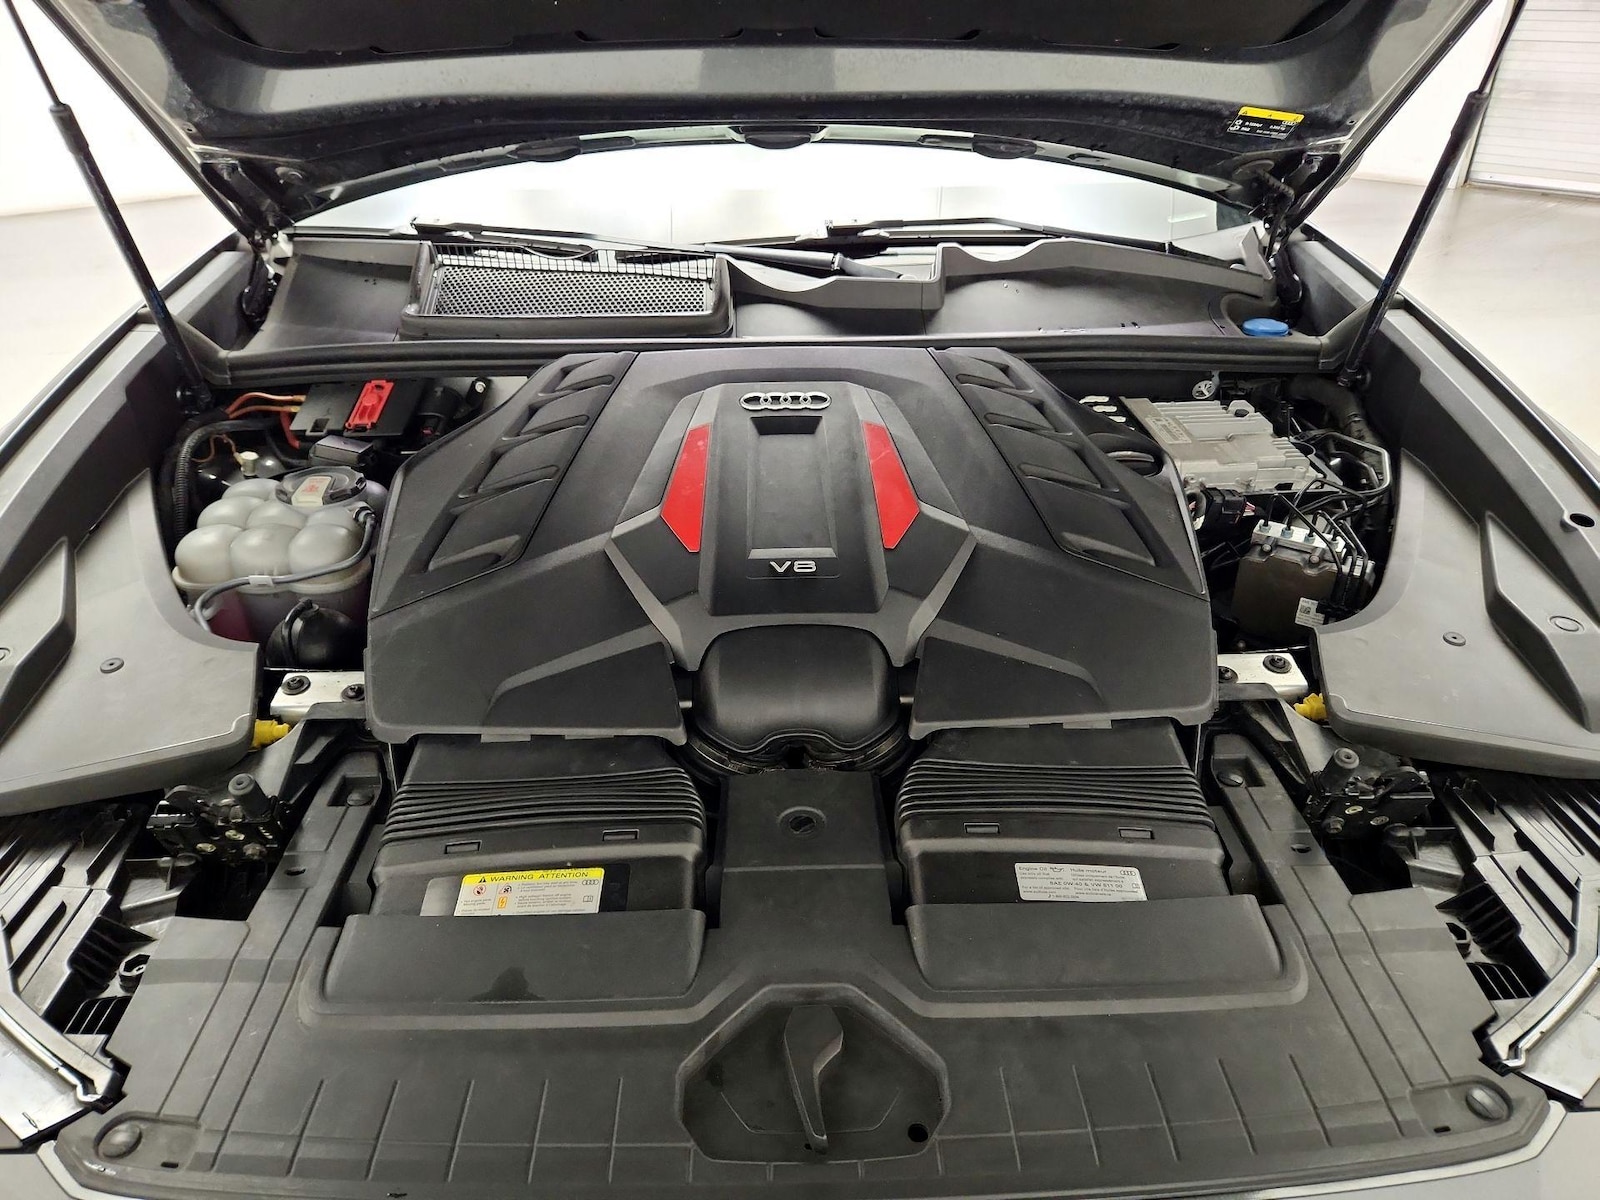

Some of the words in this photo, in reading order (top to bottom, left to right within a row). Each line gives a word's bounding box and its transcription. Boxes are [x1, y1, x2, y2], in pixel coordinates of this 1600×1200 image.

[769, 560, 817, 573] V8
[490, 873, 534, 882] WARNING
[538, 871, 589, 880] ATTENTION
